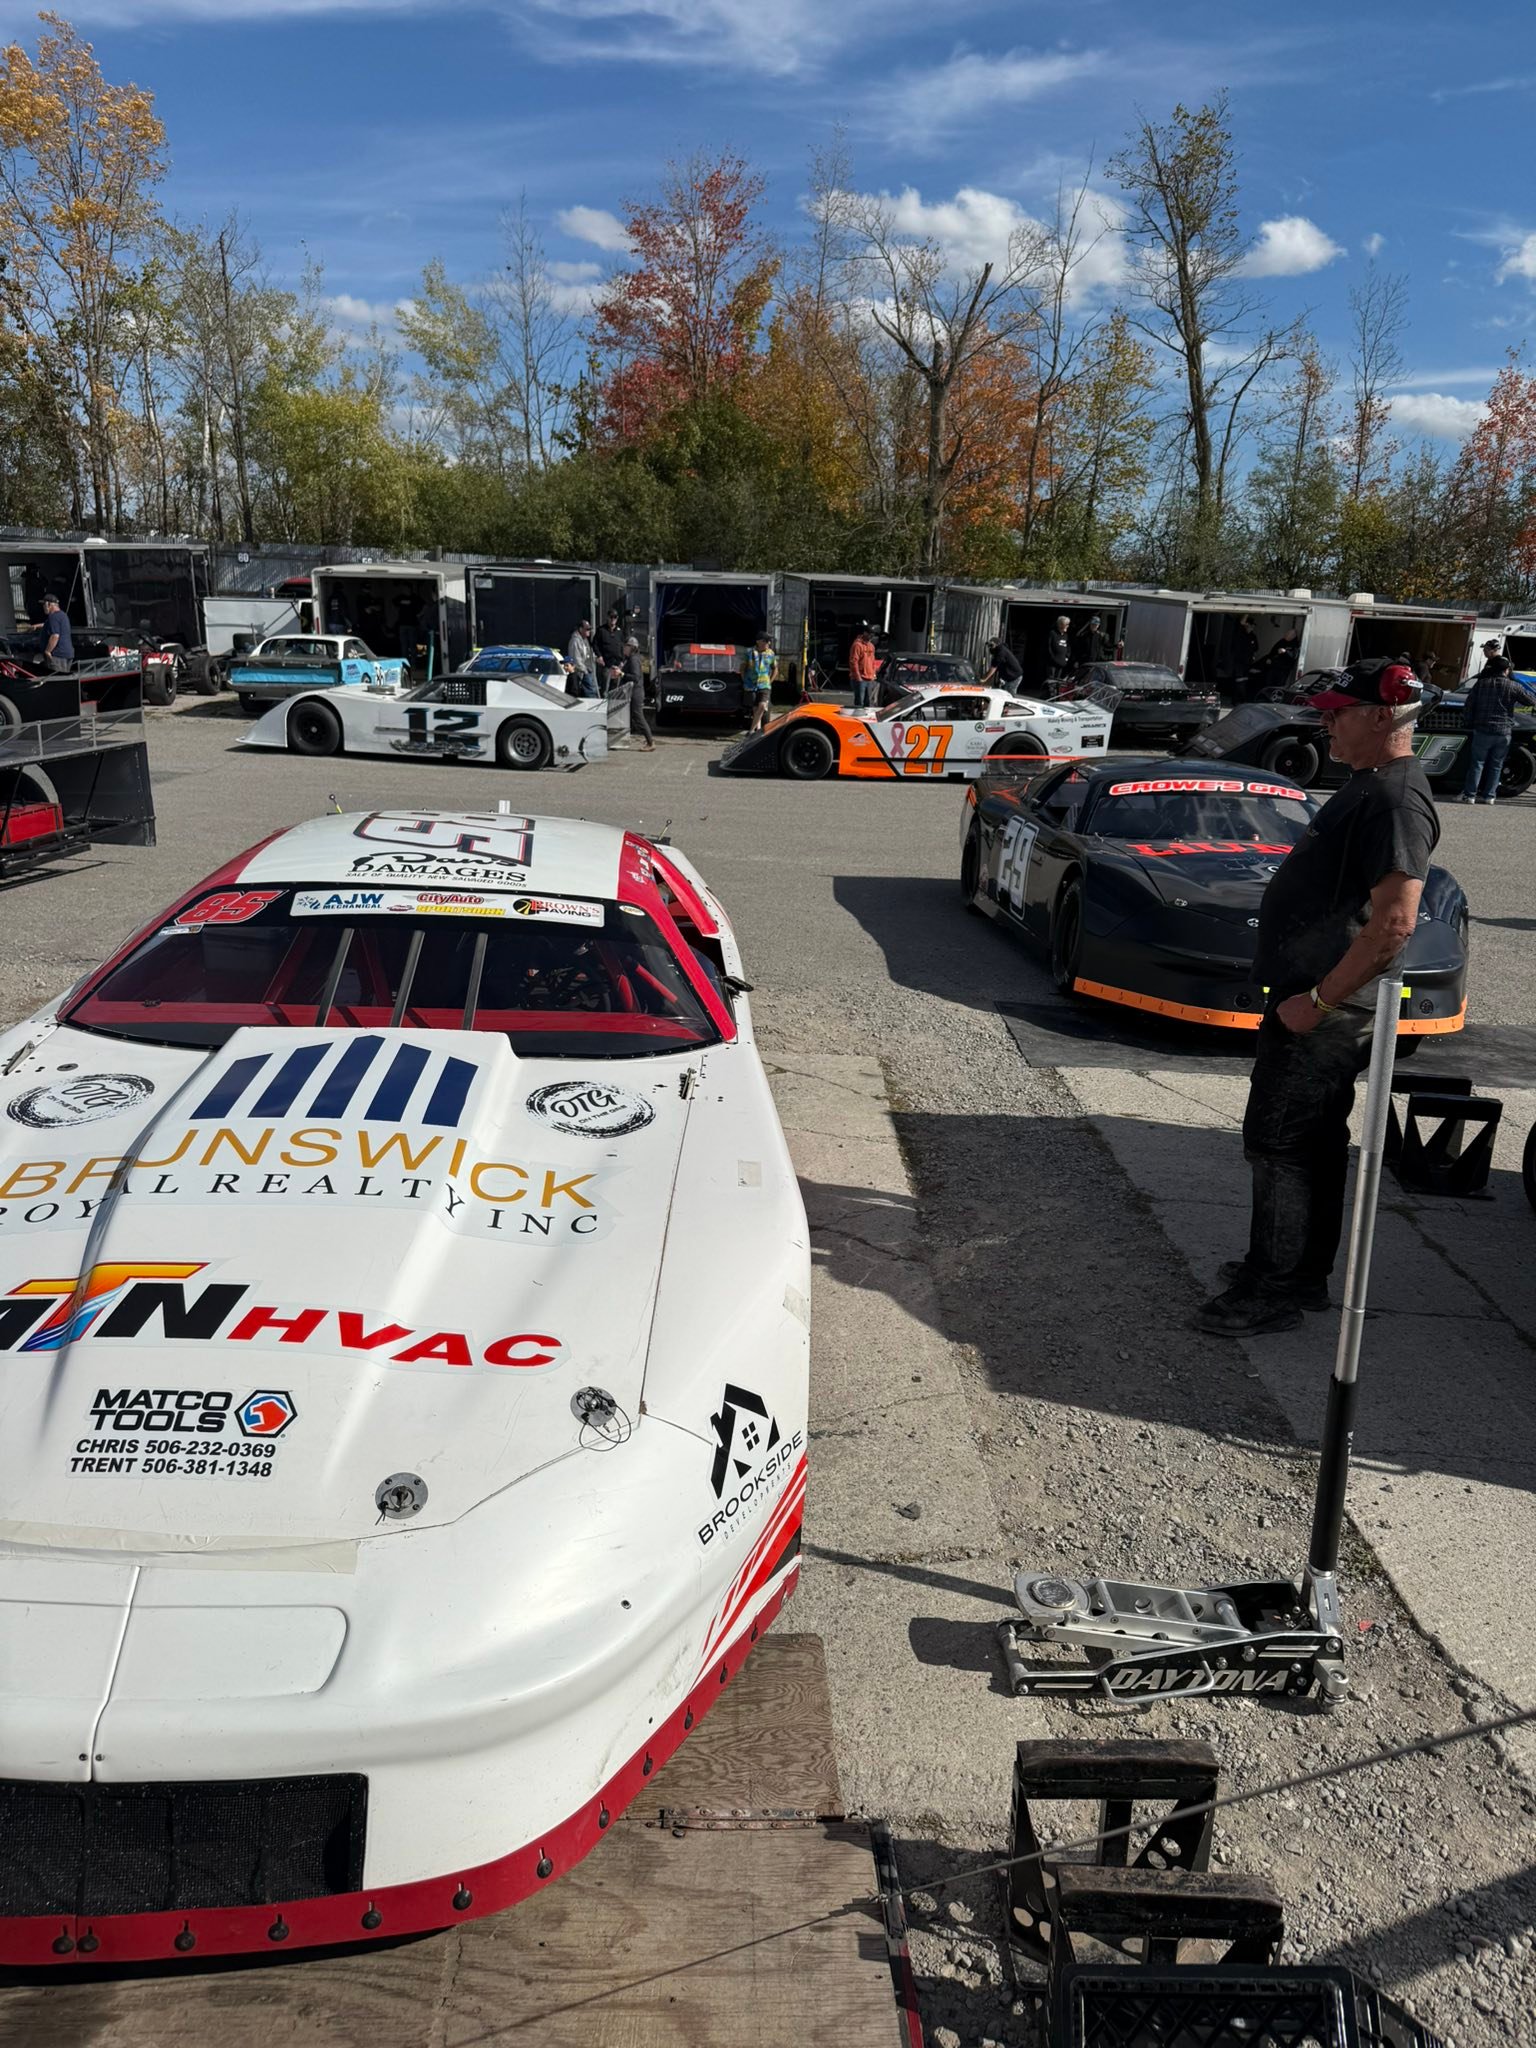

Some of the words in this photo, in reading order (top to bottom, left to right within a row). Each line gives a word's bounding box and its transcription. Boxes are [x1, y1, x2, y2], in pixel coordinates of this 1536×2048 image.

[403, 707, 484, 750] 12
[904, 724, 953, 774] 27
[1109, 780, 1244, 796] CROWE'S
[1248, 782, 1307, 801] GAS
[369, 851, 518, 867] Dan's
[997, 815, 1039, 920] 29
[347, 863, 527, 883] DAMAGES
[174, 889, 289, 926] 85
[324, 893, 384, 905] AJW
[531, 900, 600, 914] BROWN'S
[536, 907, 591, 918] PAVING
[62, 1083, 129, 1109] OTG
[550, 1090, 618, 1118] OTG
[592, 1111, 610, 1120] THE
[0, 1127, 598, 1208] BRUNSWICK
[207, 1172, 466, 1219] REALTY
[487, 1208, 598, 1236] INC
[227, 1305, 563, 1369] HVAC
[93, 1388, 233, 1411] MATCO
[89, 1409, 227, 1433] TOOLS
[75, 1438, 139, 1455] CHRIS
[144, 1438, 276, 1459] 506-232-0369
[70, 1457, 137, 1474] TRENT
[141, 1458, 273, 1478] 506-381-1348
[698, 1430, 803, 1546] BROOKSIDE
[724, 1462, 792, 1541] DEVELOPMENTS
[1110, 1667, 1289, 1692] DAYTONA
